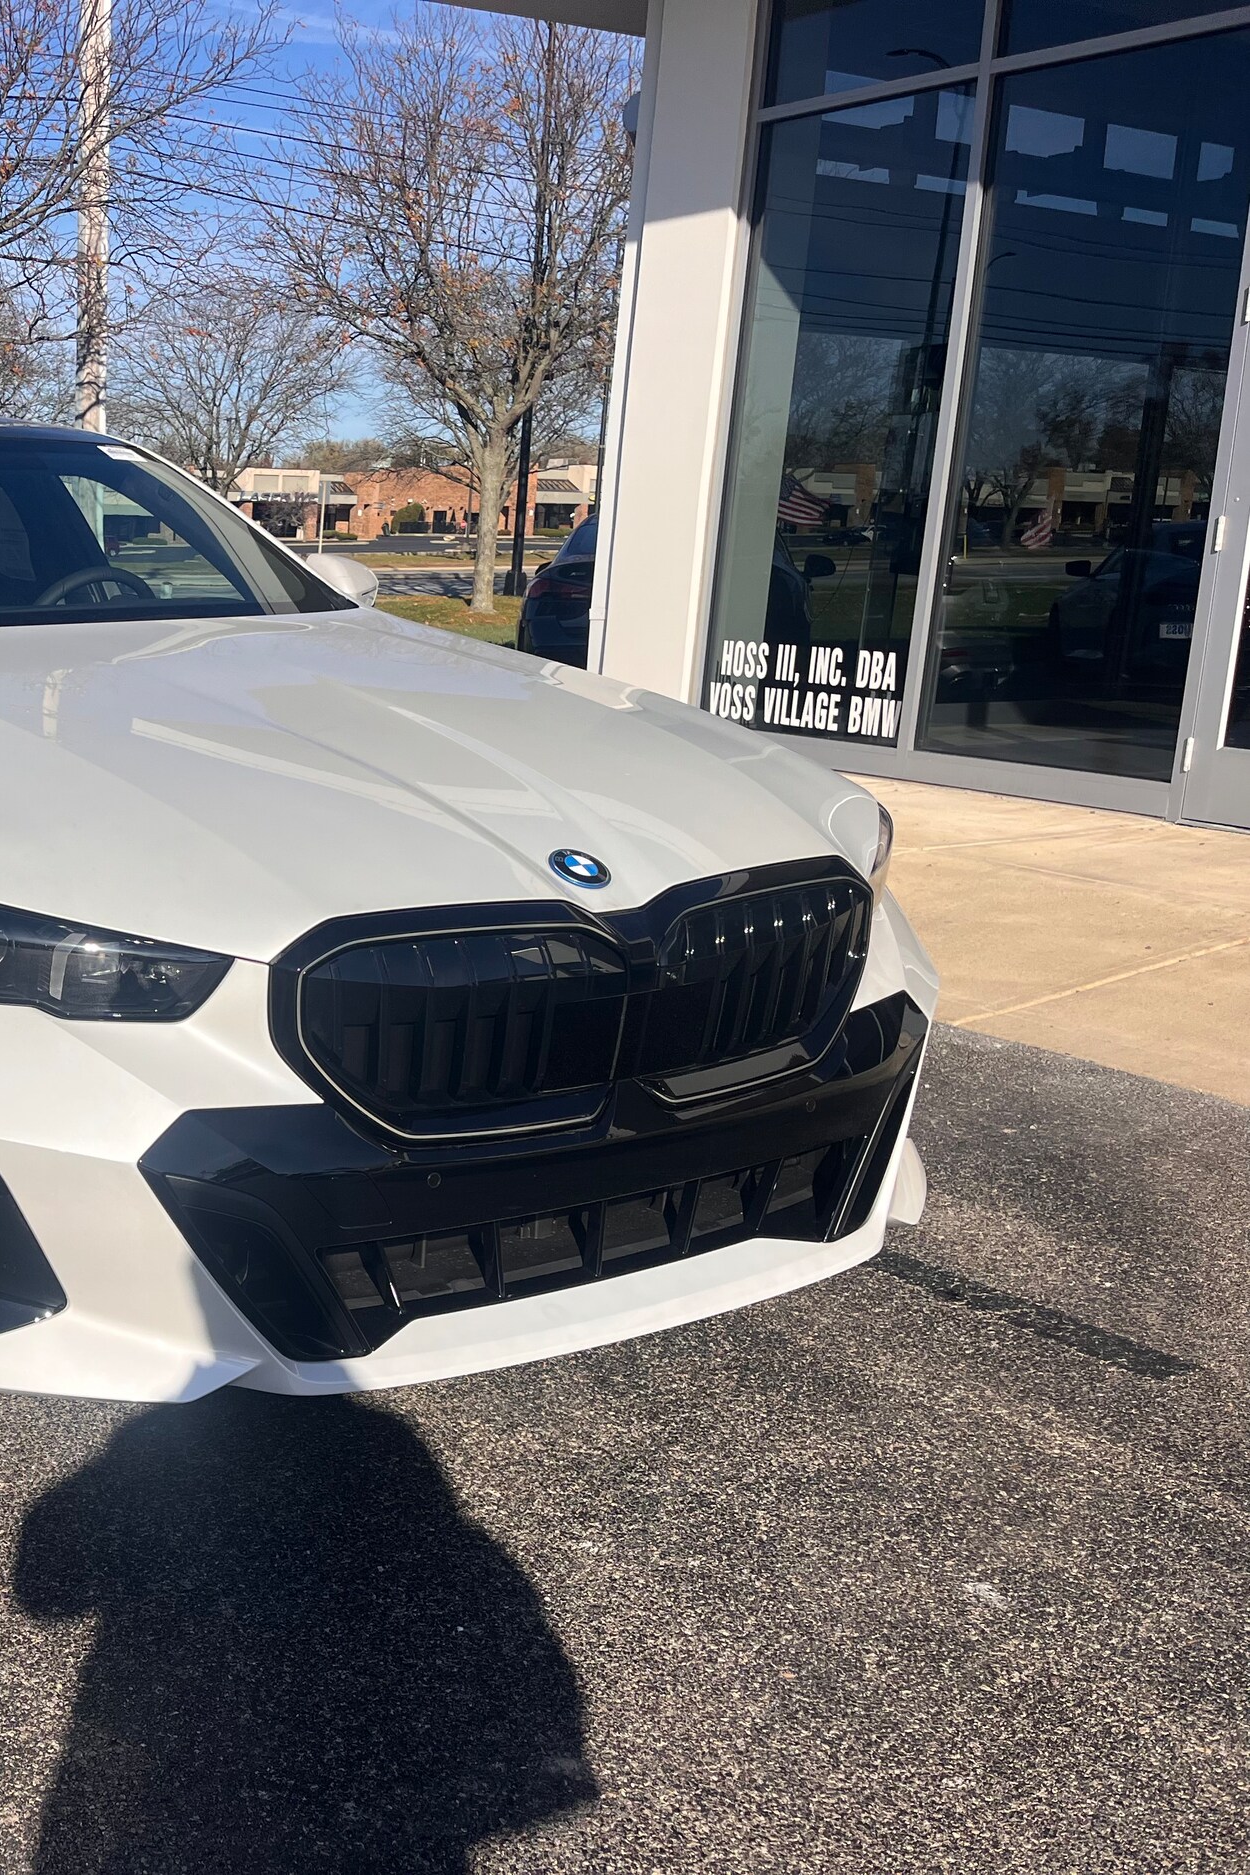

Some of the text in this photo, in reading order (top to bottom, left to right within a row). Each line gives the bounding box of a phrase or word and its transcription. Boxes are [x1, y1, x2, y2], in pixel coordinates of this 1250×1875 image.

[720, 640, 897, 692] HOSS III, INC. DBA
[709, 681, 902, 739] VOSS VILLAGE BMW
